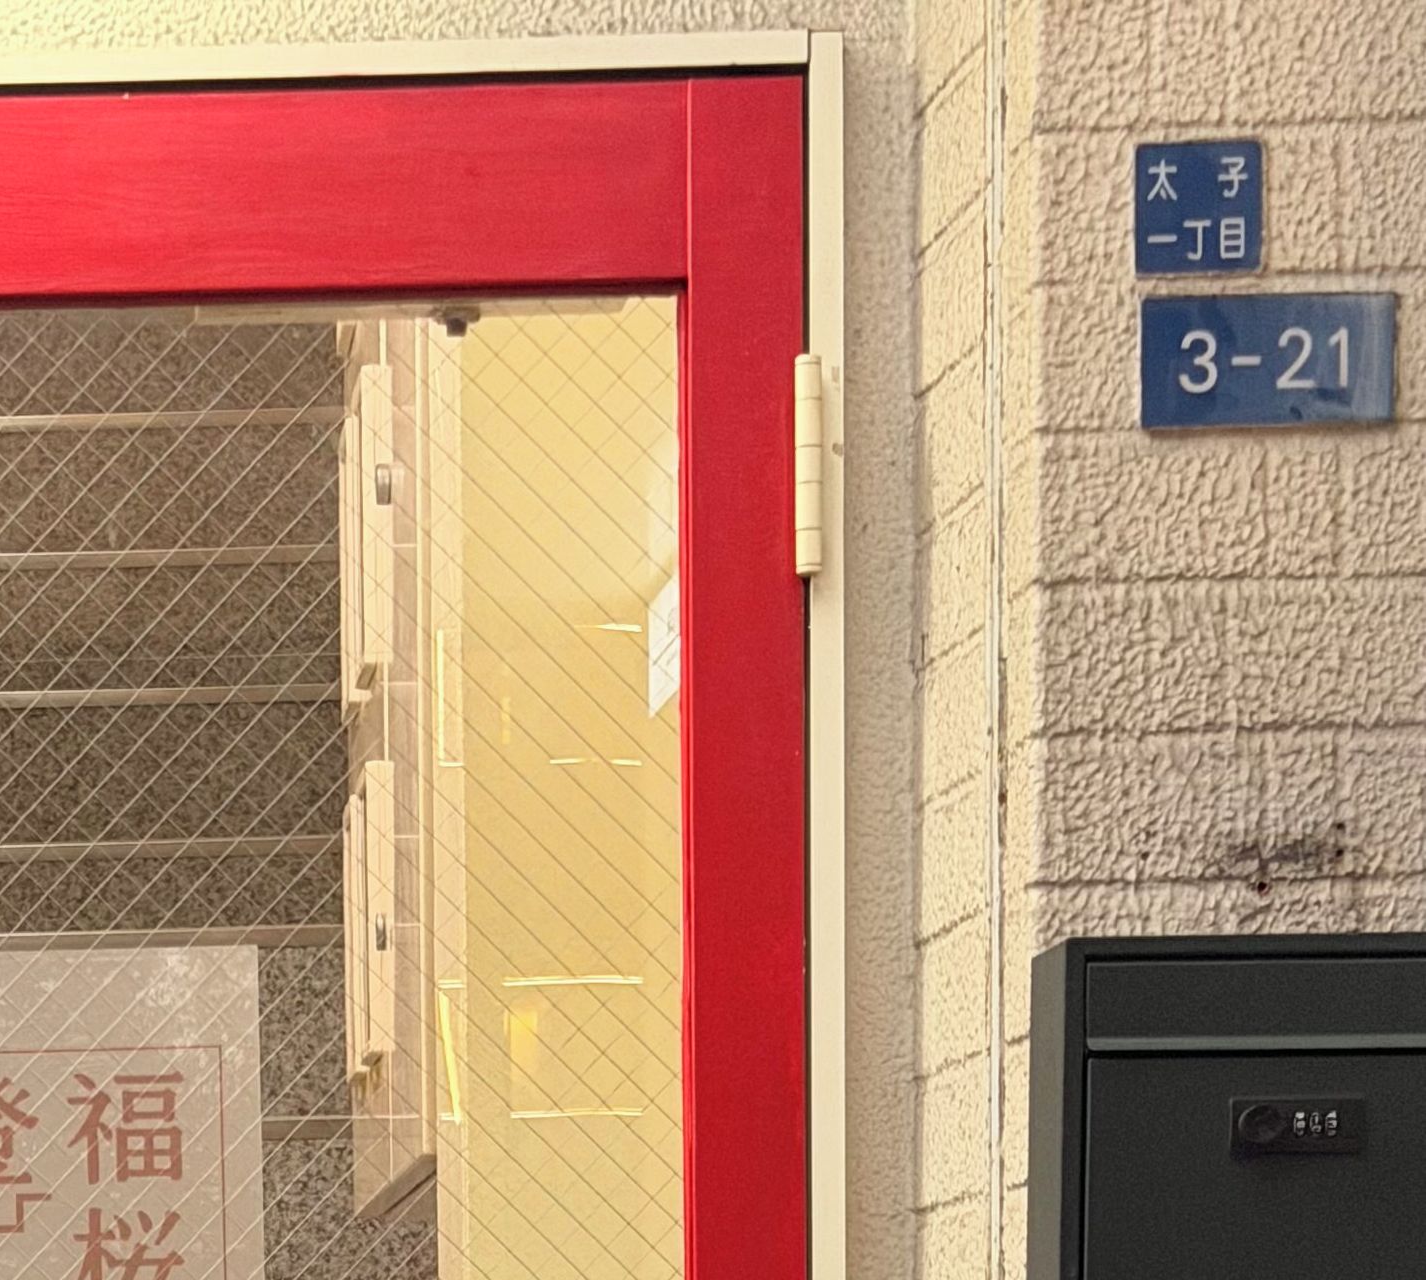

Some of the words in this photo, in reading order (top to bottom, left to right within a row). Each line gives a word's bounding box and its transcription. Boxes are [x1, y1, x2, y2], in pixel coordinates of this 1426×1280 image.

[1147, 156, 1248, 201] 太子
[1147, 216, 1246, 260] 一丁目
[1178, 326, 1349, 394] 3-21
